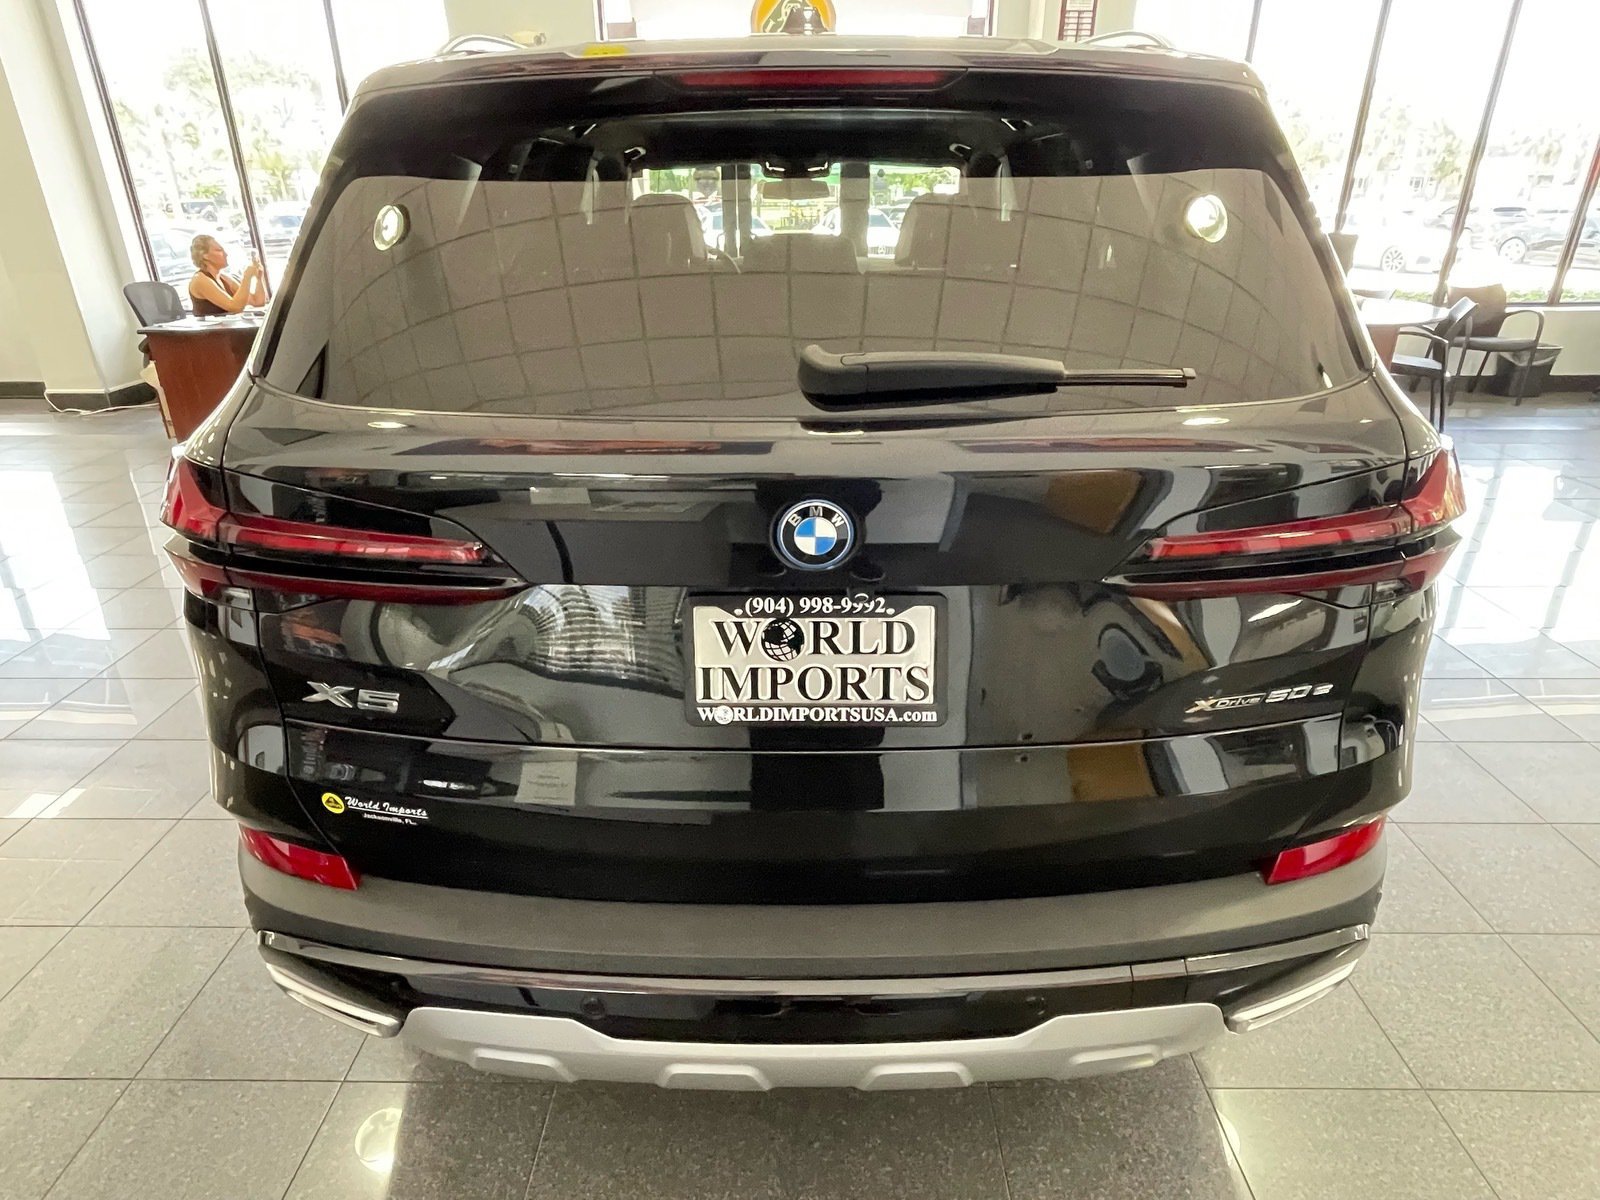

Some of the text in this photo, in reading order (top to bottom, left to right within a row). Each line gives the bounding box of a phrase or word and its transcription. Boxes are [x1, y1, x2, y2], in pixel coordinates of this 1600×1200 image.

[788, 506, 845, 528] BMW
[745, 597, 794, 617] (904)
[711, 618, 915, 662] WORLD
[699, 666, 930, 701] IMPORTS
[302, 681, 400, 714] X5
[696, 705, 938, 725] WORLDIMPORTSUSA.com
[344, 796, 380, 810] World
[382, 802, 428, 817] Imports
